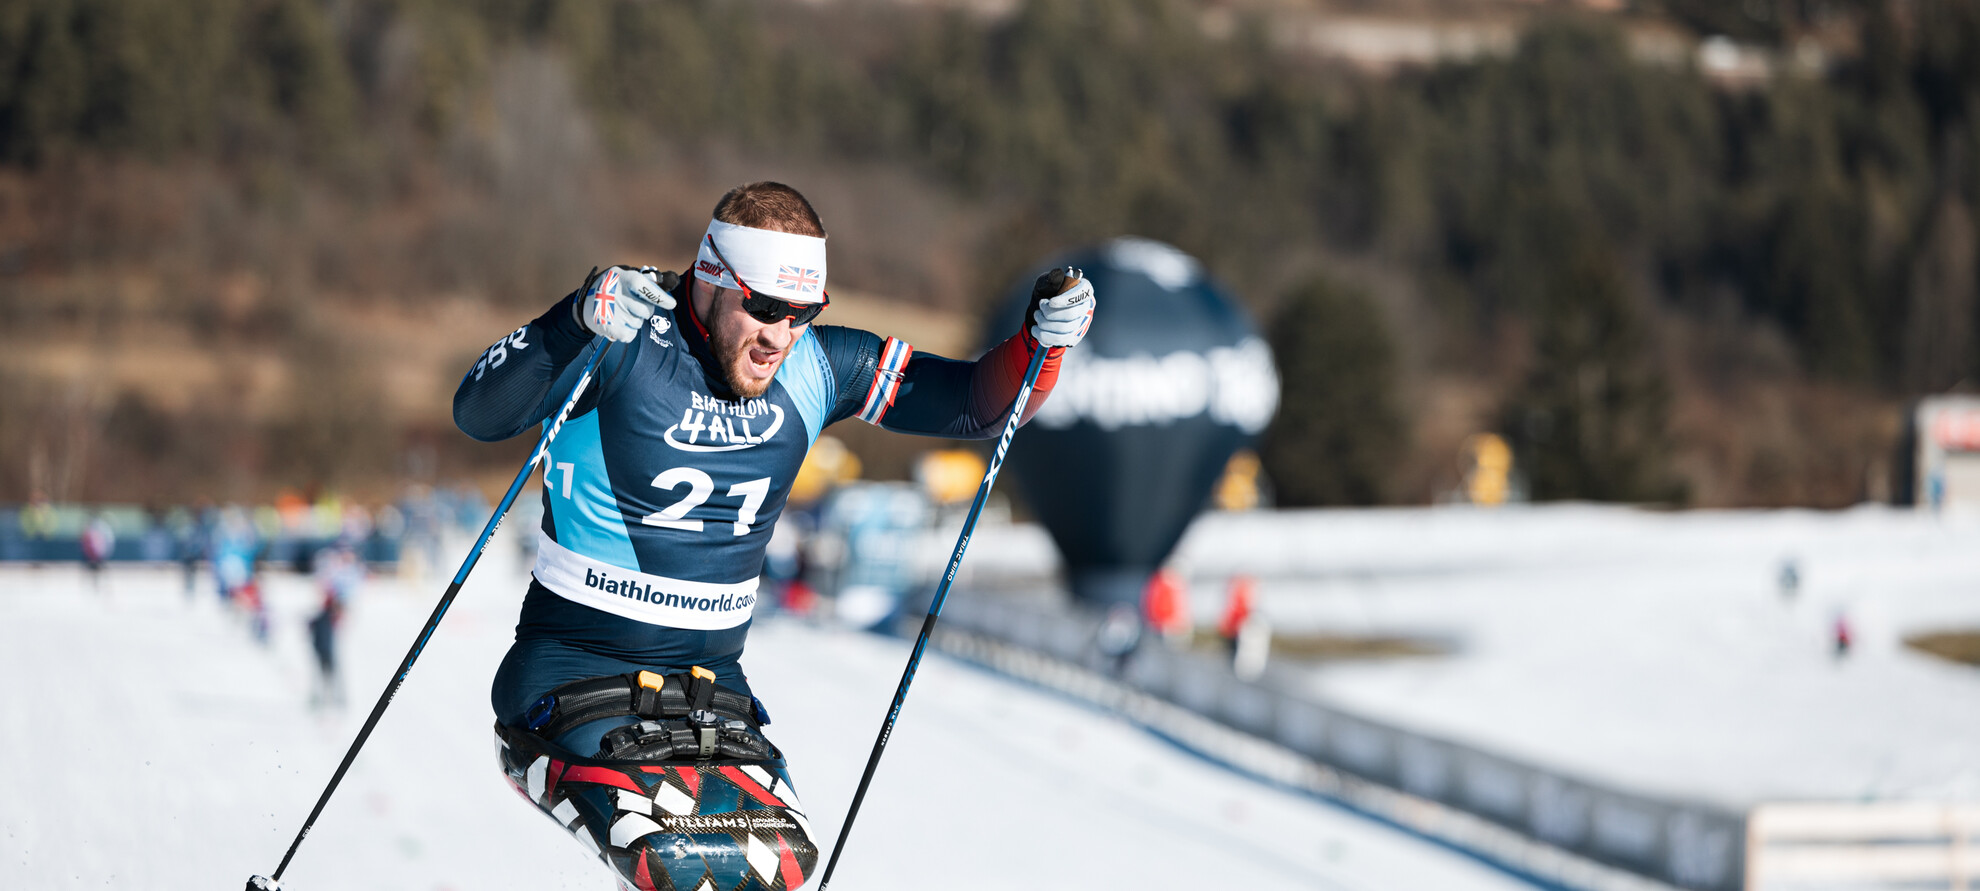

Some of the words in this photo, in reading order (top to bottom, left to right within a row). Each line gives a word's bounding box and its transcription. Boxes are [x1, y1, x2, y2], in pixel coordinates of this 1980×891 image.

[543, 450, 575, 500] 21
[641, 466, 772, 537] 21
[954, 535, 970, 561] TRIAC
[947, 561, 960, 582] GIRO
[584, 568, 756, 612] biathlonworld.com
[661, 816, 747, 829] WILLIAMS
